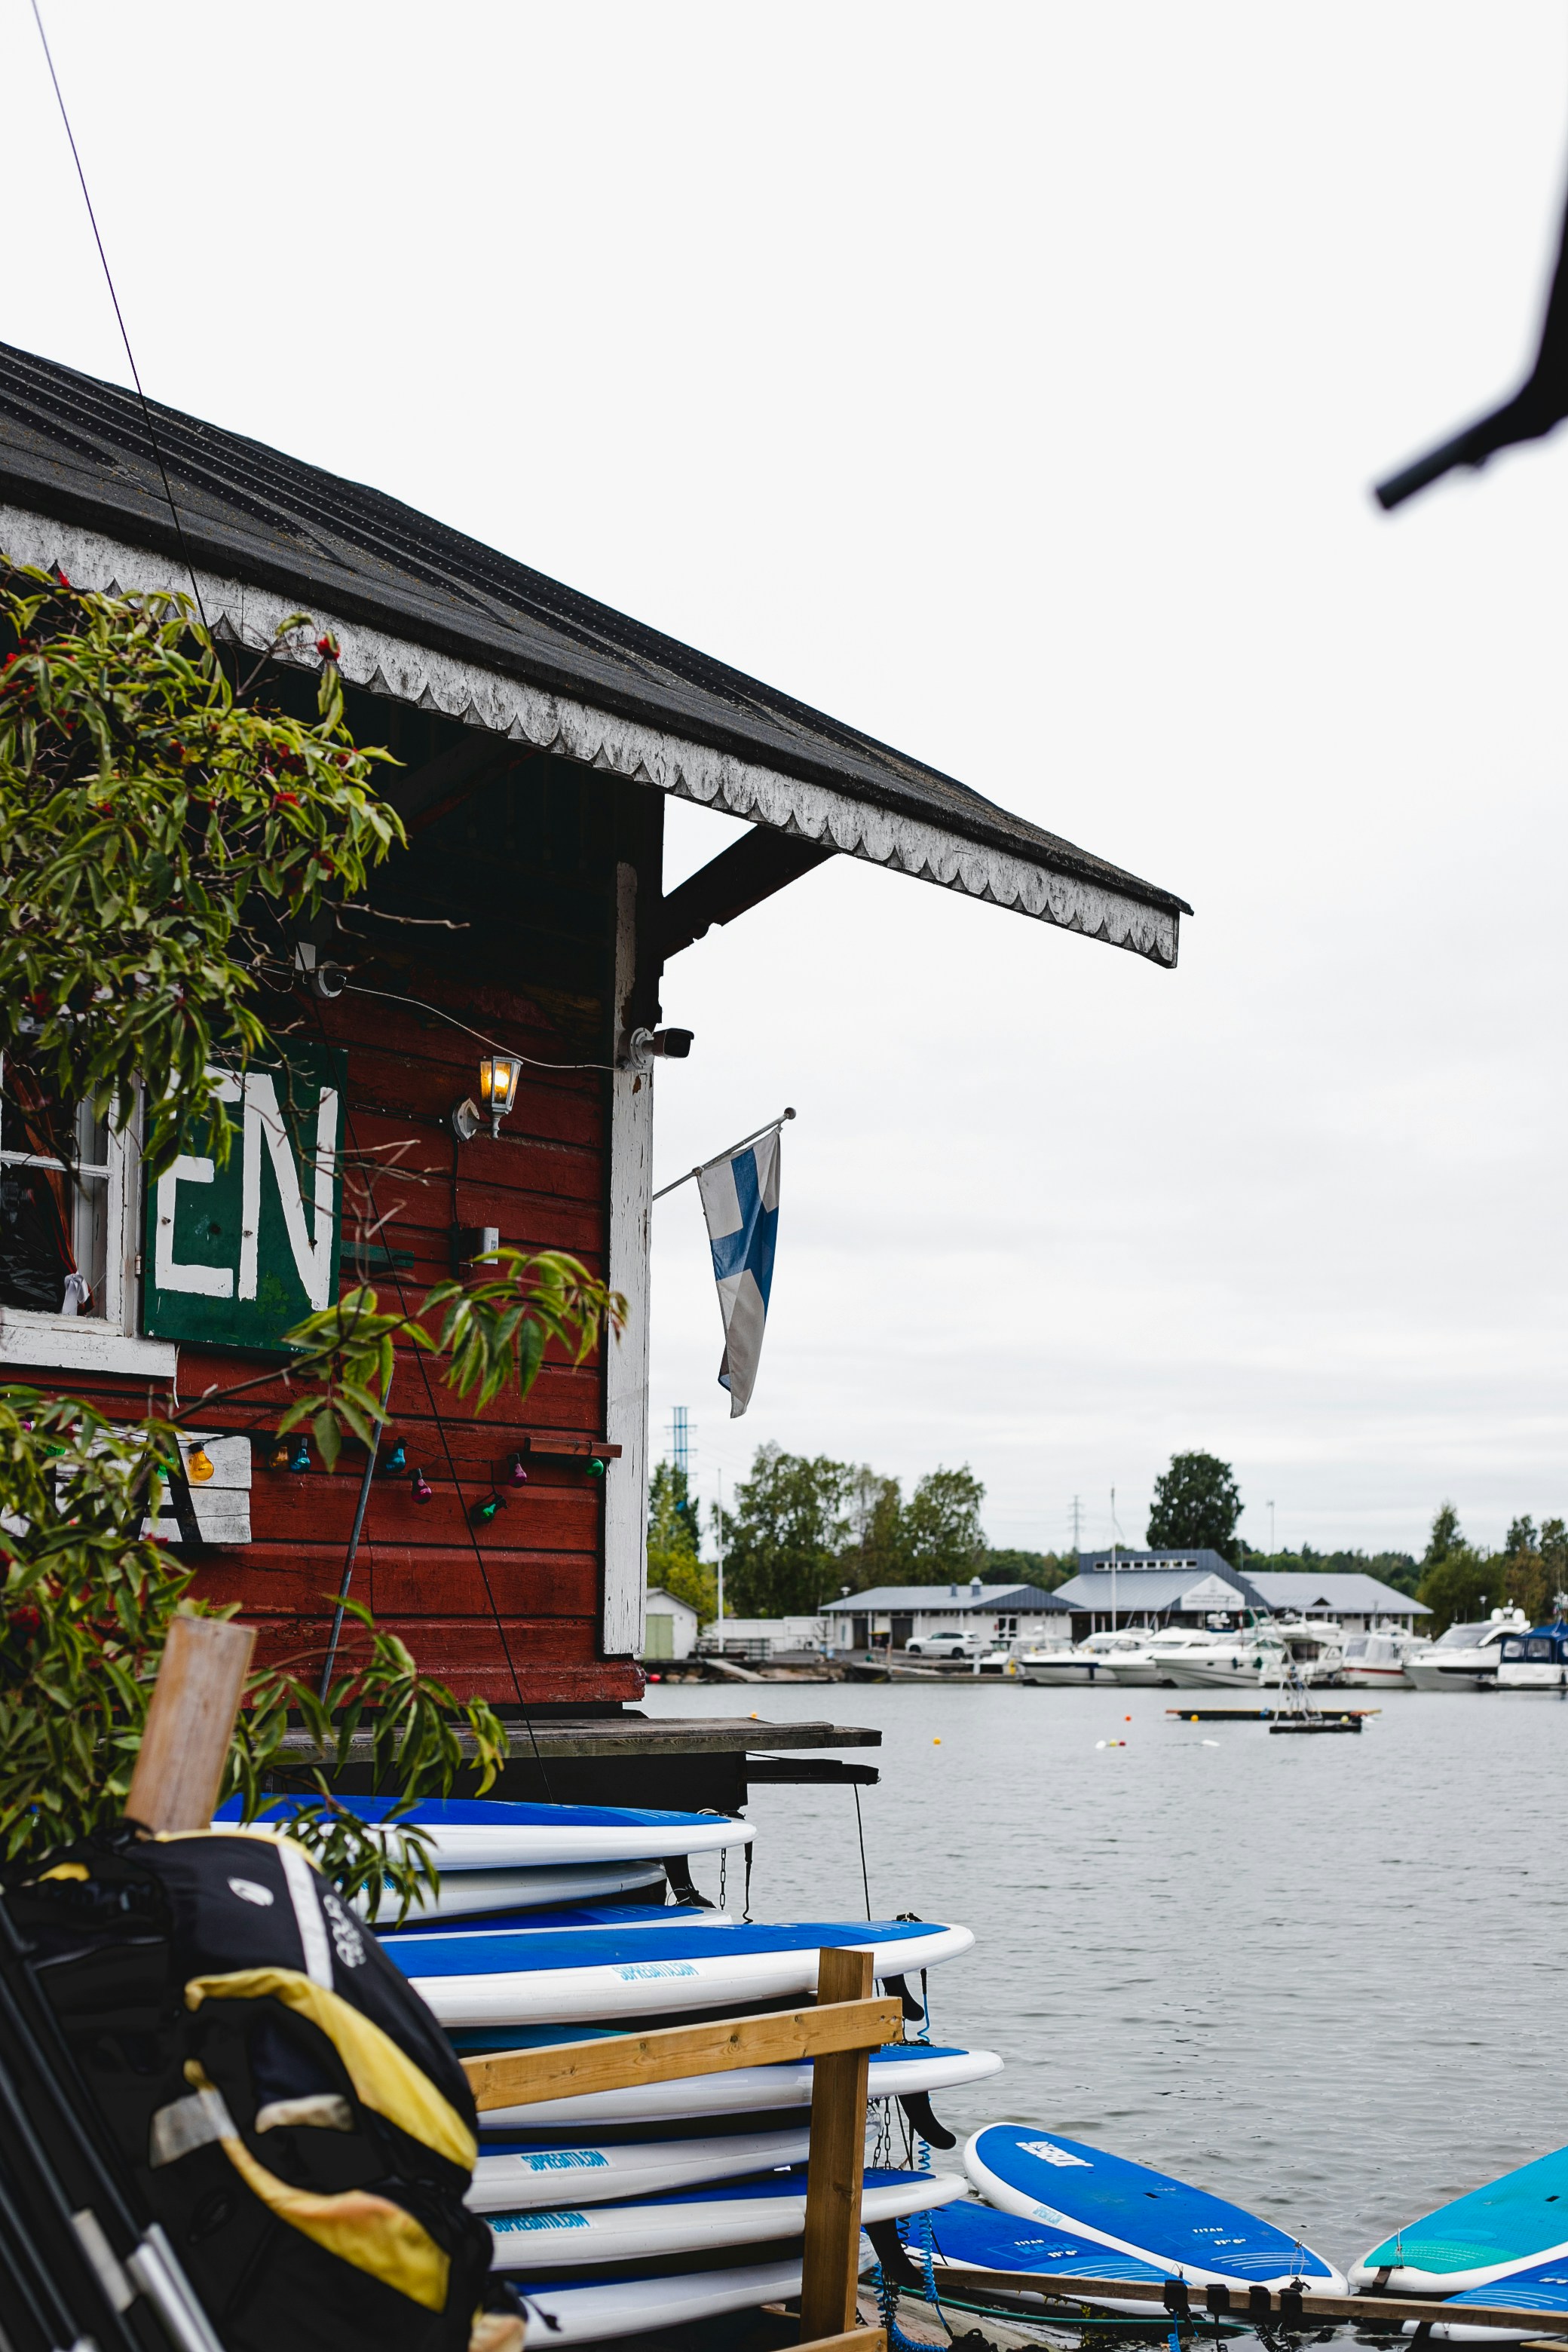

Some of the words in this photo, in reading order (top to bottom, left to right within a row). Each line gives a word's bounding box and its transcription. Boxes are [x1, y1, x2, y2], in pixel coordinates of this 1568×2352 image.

[611, 1963, 700, 1981] SUPREGATTA.COM
[521, 2151, 609, 2171] SUPREGATTA.COM
[485, 2213, 590, 2232] SUPREGATTA.COM
